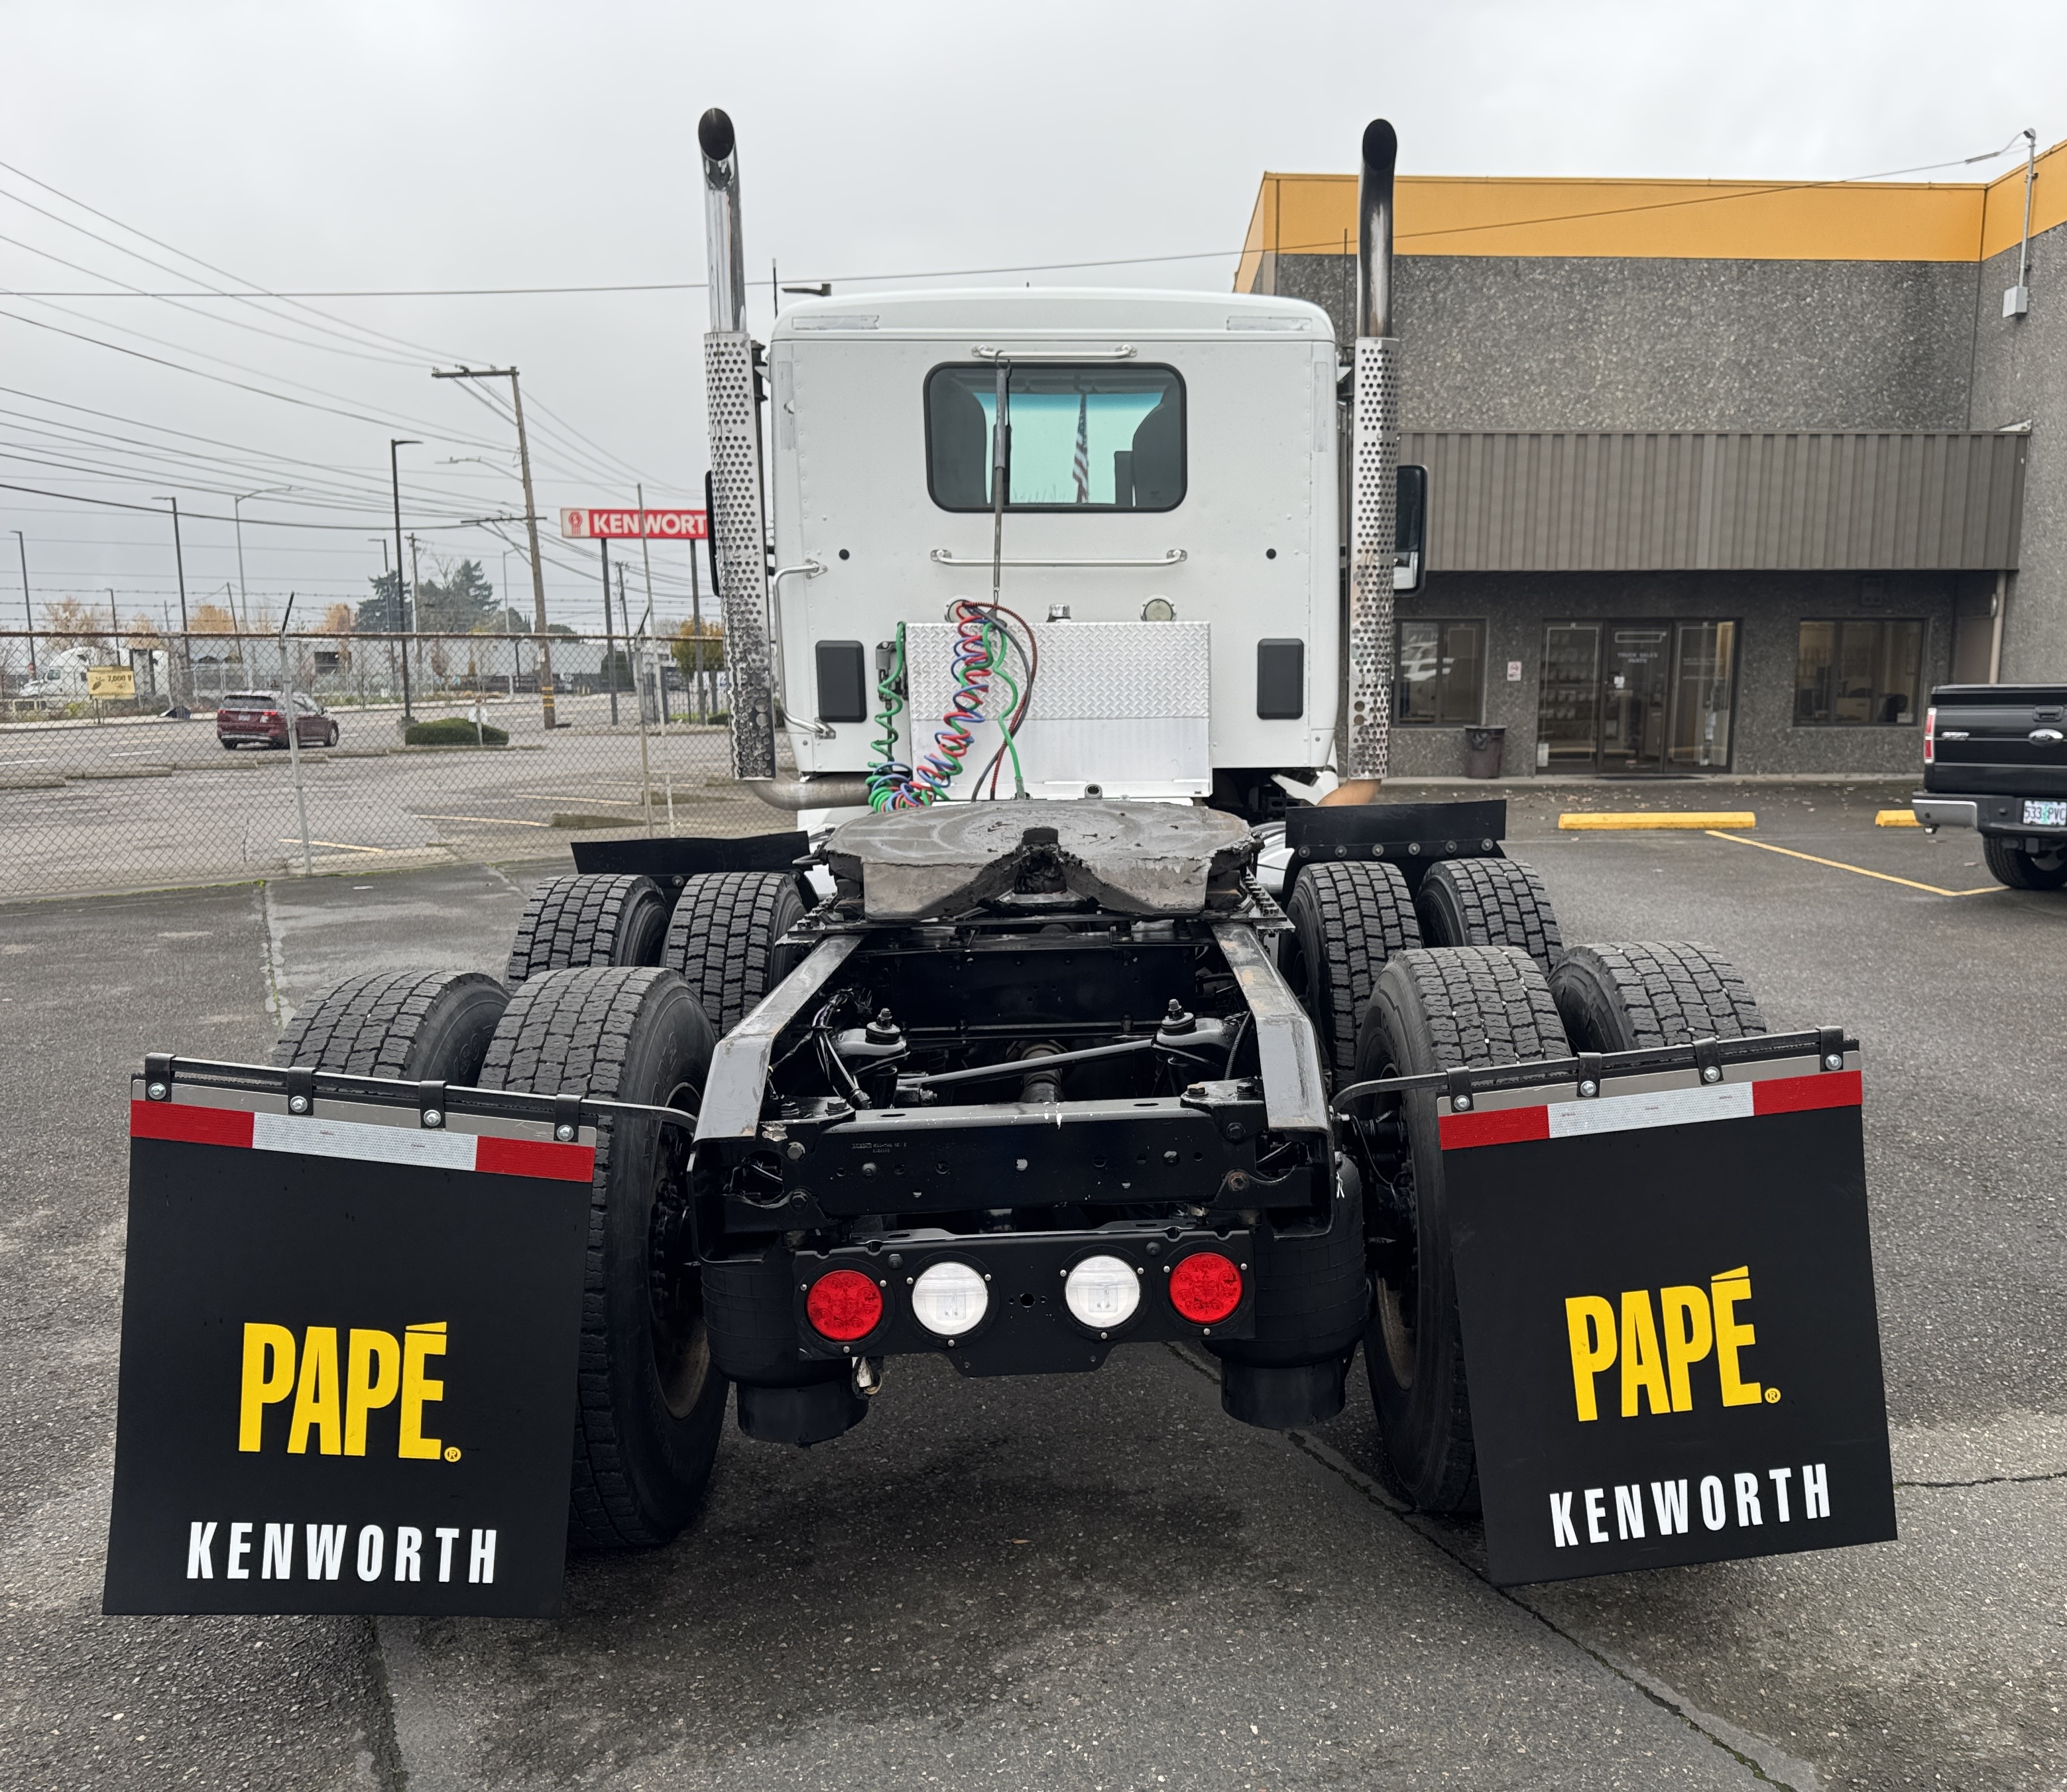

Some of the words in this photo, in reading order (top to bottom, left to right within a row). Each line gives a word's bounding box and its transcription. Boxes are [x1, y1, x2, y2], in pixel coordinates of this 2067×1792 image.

[593, 512, 707, 534] KENWORT
[2025, 806, 2042, 819] 533
[1549, 1463, 1831, 1548] KENWORTH
[187, 1522, 497, 1584] KENWORTH
